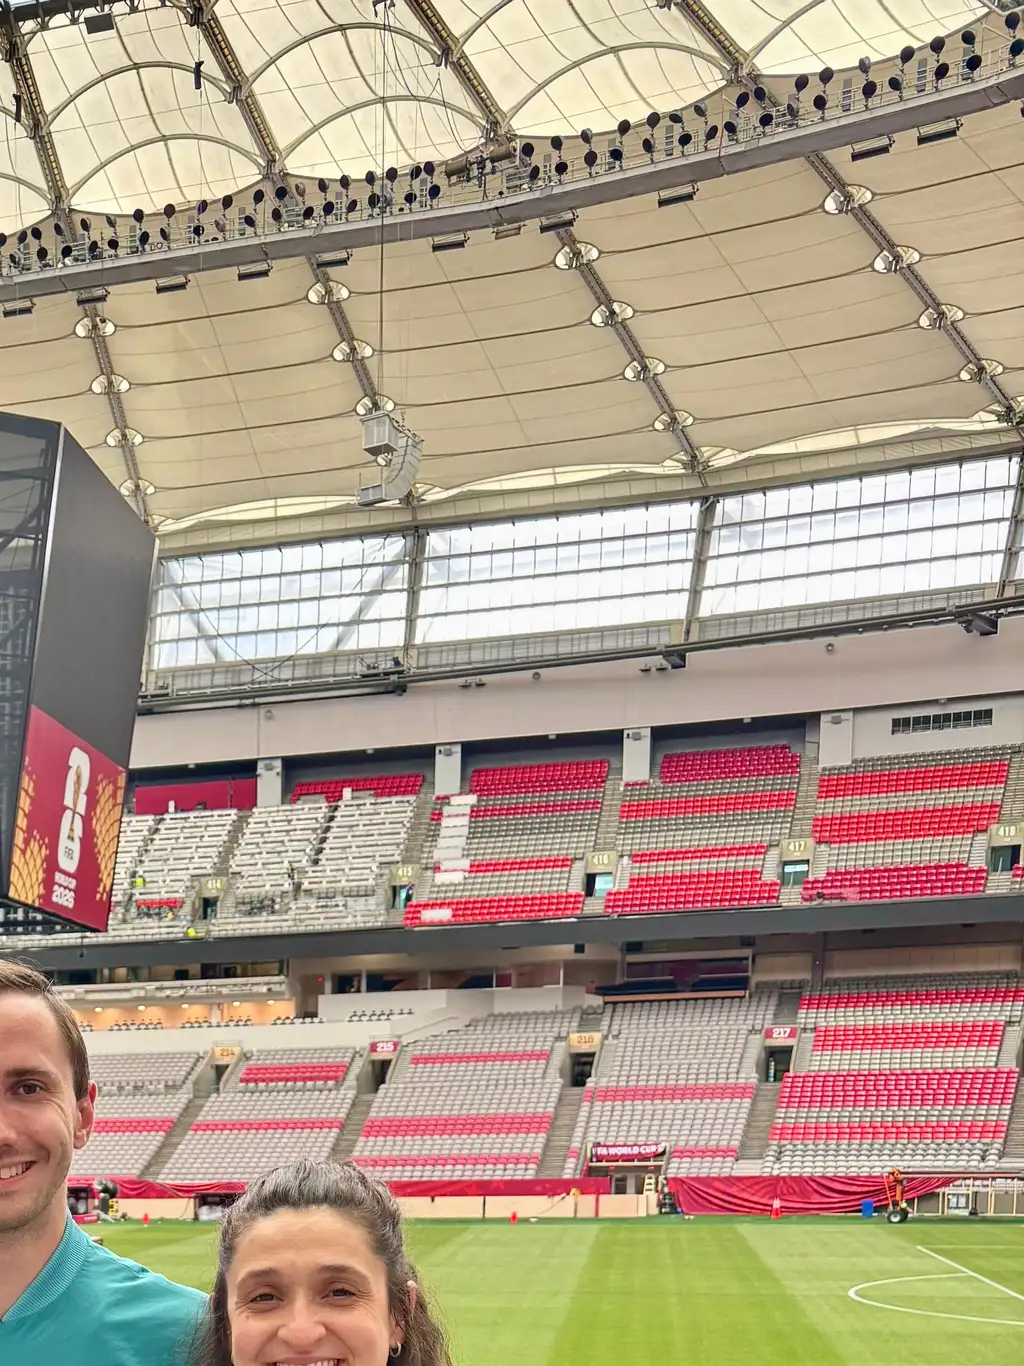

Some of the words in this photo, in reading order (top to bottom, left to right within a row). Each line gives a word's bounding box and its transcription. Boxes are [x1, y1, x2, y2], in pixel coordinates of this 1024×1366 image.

[788, 841, 806, 851] 417
[397, 866, 413, 877] 415
[771, 1027, 792, 1038] 217
[608, 1146, 639, 1156] WORLD
[639, 1145, 656, 1154] CUP
